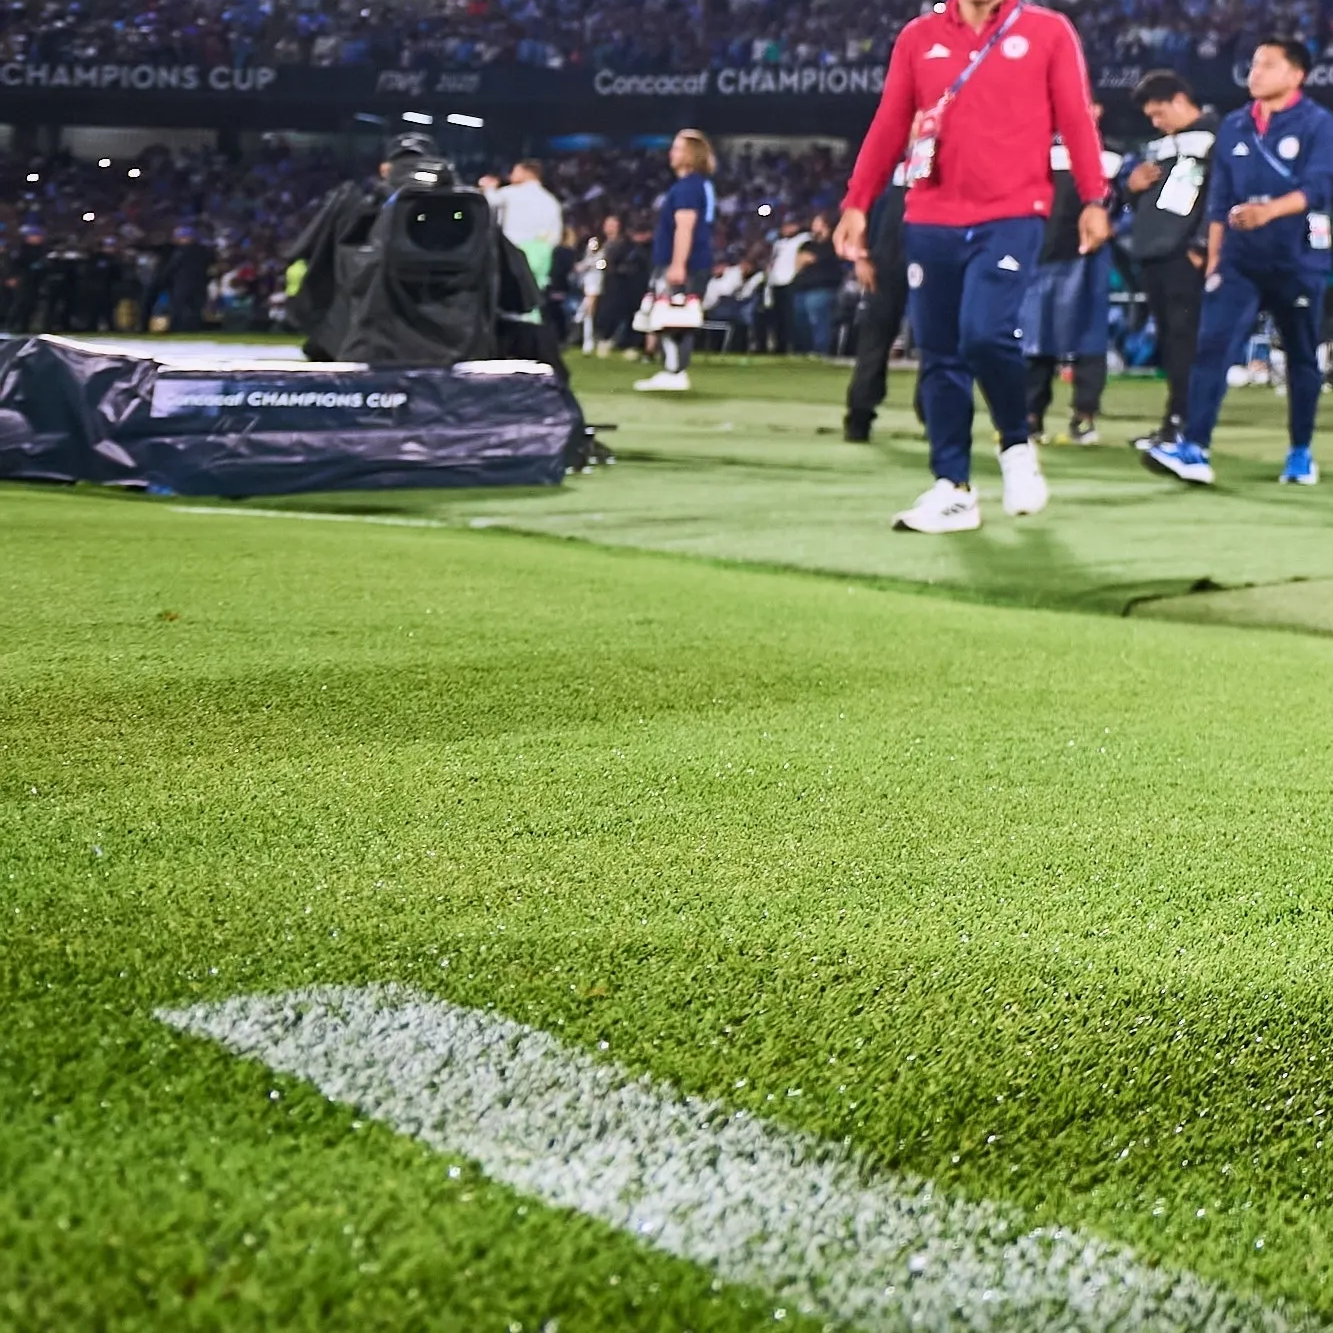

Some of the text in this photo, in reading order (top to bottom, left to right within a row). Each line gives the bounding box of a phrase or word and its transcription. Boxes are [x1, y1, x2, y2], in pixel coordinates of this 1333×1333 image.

[0, 63, 277, 91] CHAMPIONS CUP
[594, 64, 886, 95] Concacaf CHAMPIONS
[247, 391, 363, 408] CHAMPIONS
[366, 392, 408, 408] CUP
